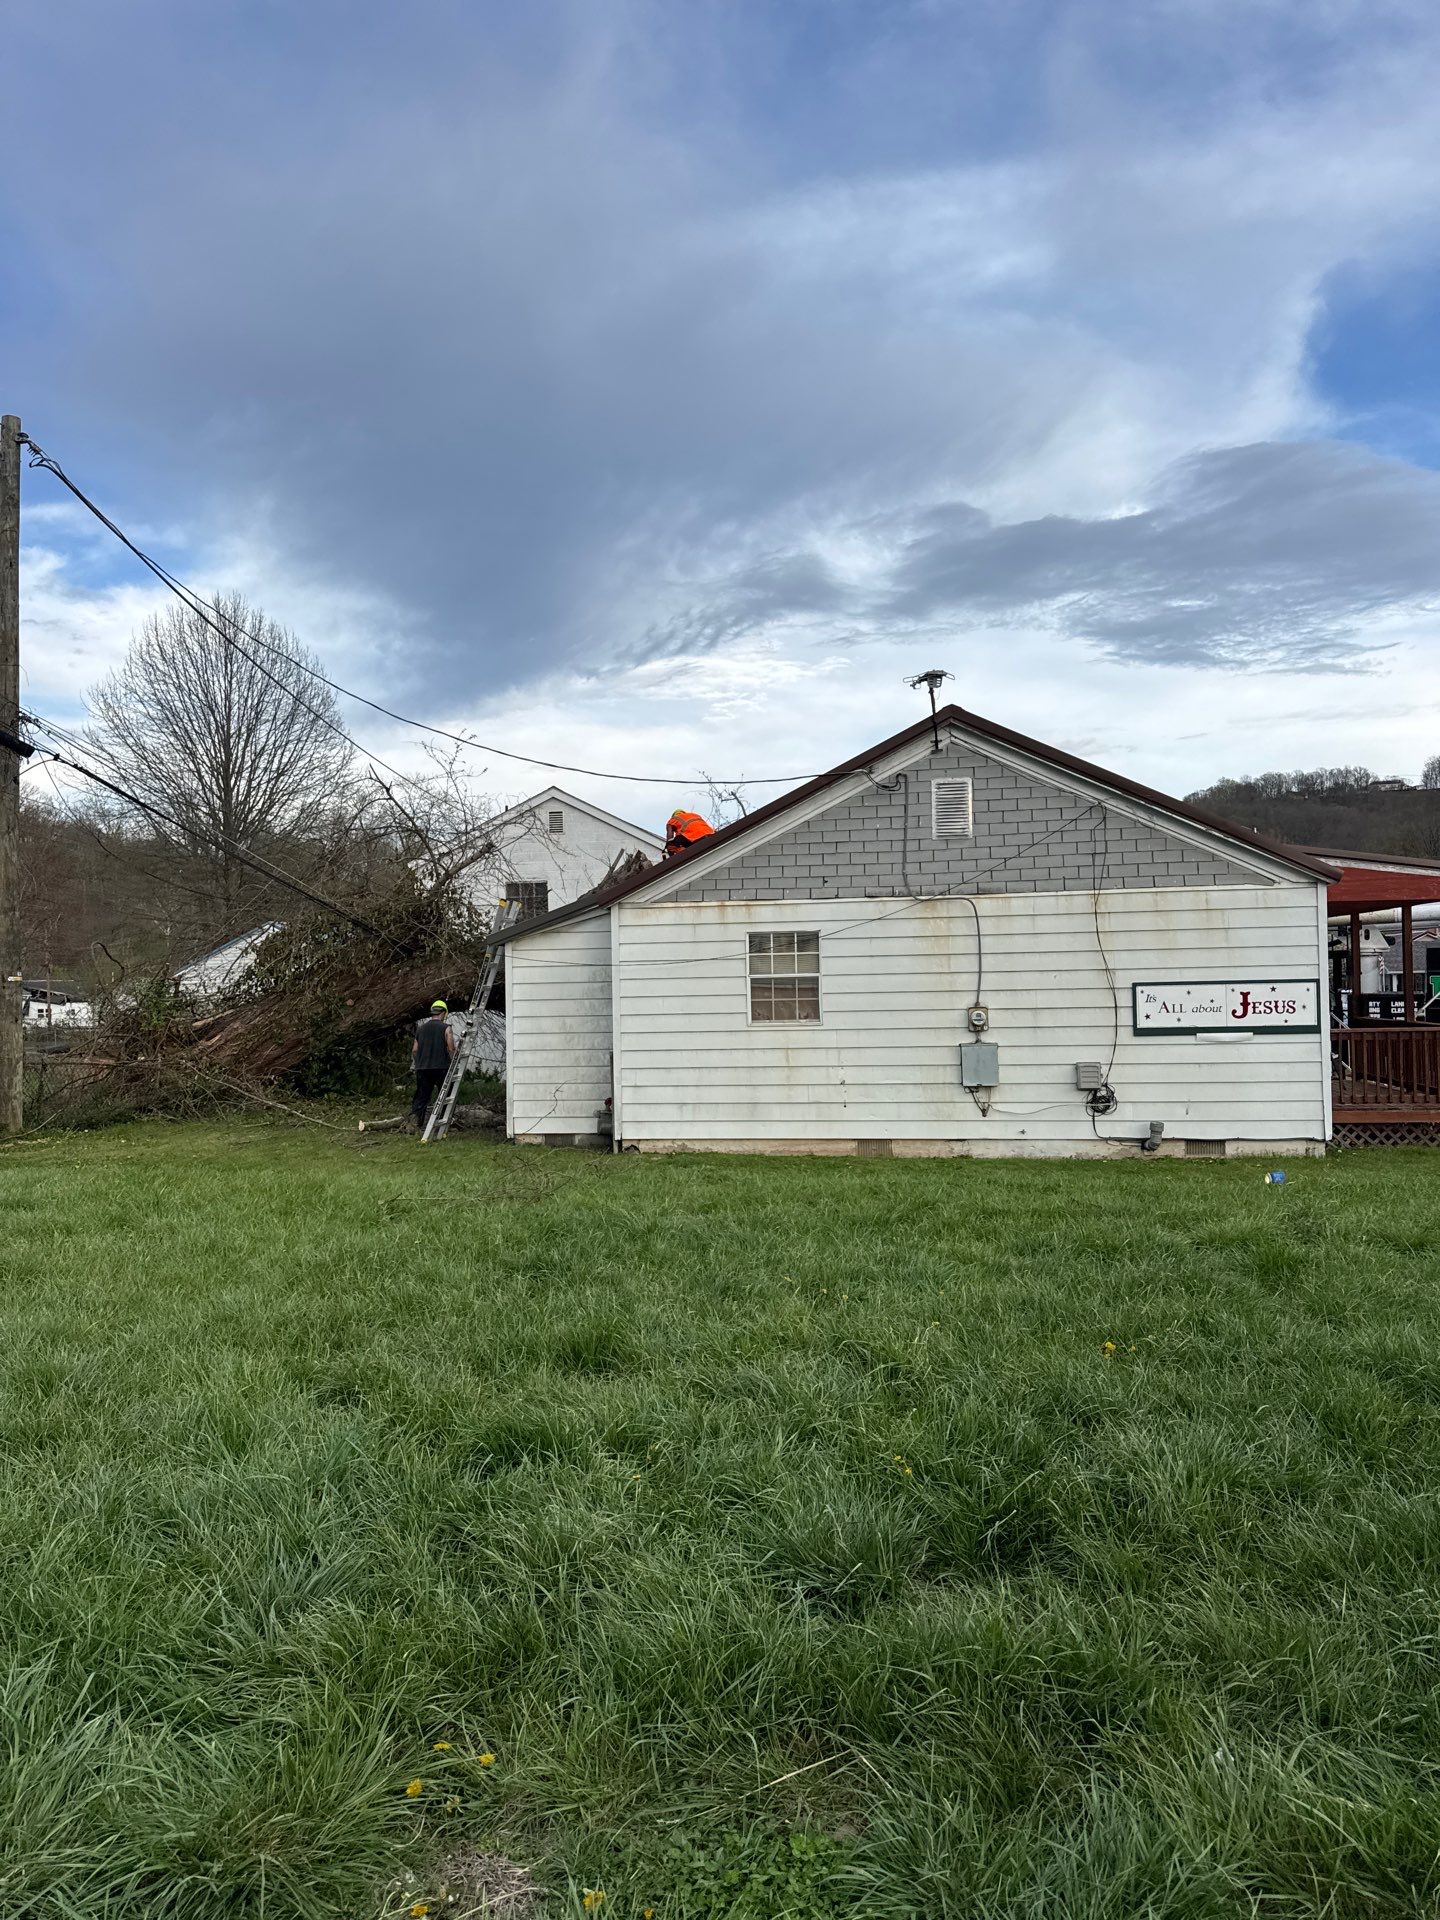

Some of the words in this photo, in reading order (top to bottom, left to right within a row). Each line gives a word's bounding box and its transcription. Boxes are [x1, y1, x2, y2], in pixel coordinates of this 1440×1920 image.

[1158, 1001, 1187, 1013] ALL
[1191, 1003, 1223, 1013] about
[1231, 991, 1297, 1019] JESUS
